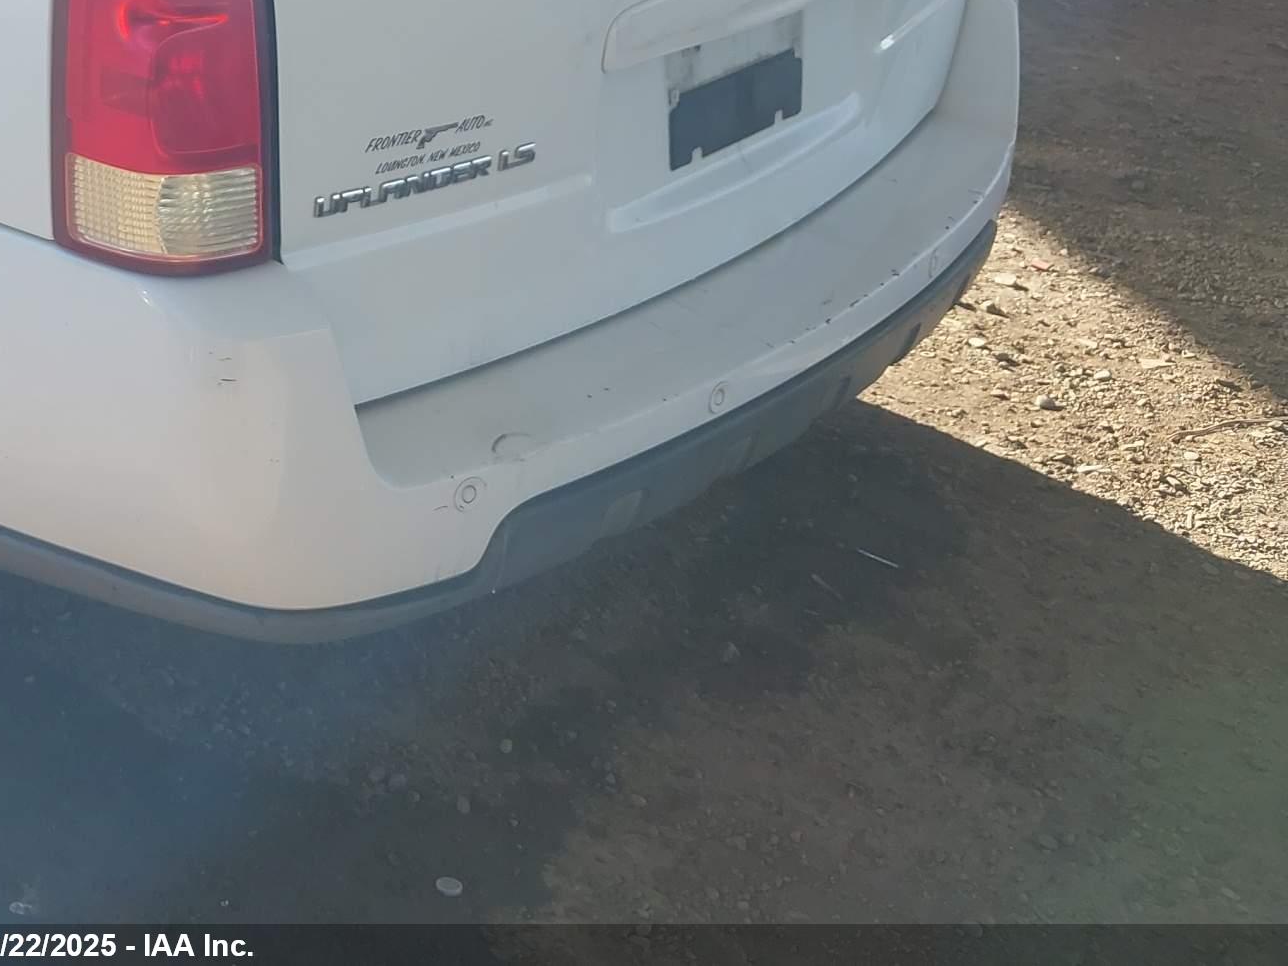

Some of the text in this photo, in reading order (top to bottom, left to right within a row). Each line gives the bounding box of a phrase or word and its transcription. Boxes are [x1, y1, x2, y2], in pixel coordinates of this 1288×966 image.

[365, 129, 422, 153] FRONTIER
[455, 114, 486, 133] AUTO
[427, 147, 450, 162] NEW
[449, 141, 481, 158] MEXICO
[313, 141, 537, 218] UPLANDER LS
